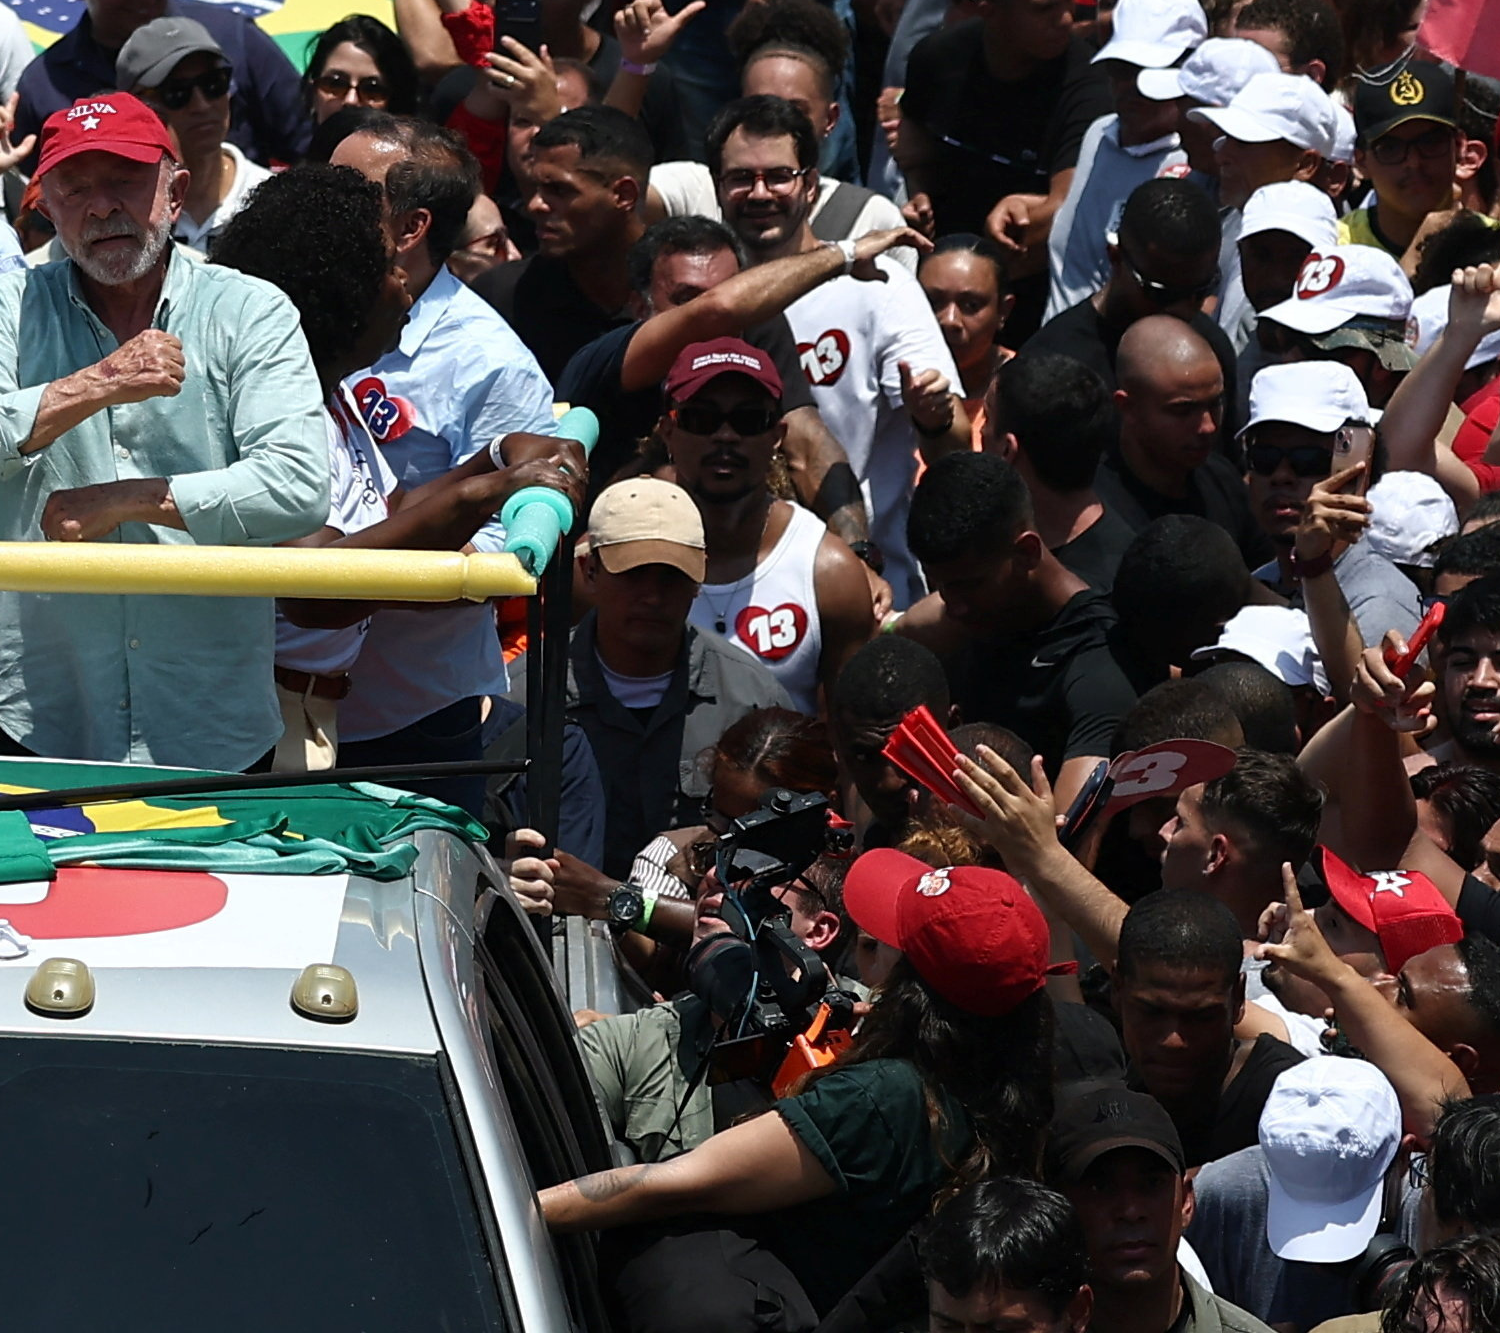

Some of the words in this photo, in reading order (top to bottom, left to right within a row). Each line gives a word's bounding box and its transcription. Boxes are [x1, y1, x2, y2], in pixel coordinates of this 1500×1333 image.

[65, 101, 118, 123] SILVA
[1298, 258, 1337, 292] 13
[799, 335, 844, 384] 13
[361, 386, 400, 440] 13
[748, 608, 798, 654] 13
[1112, 750, 1188, 798] 3
